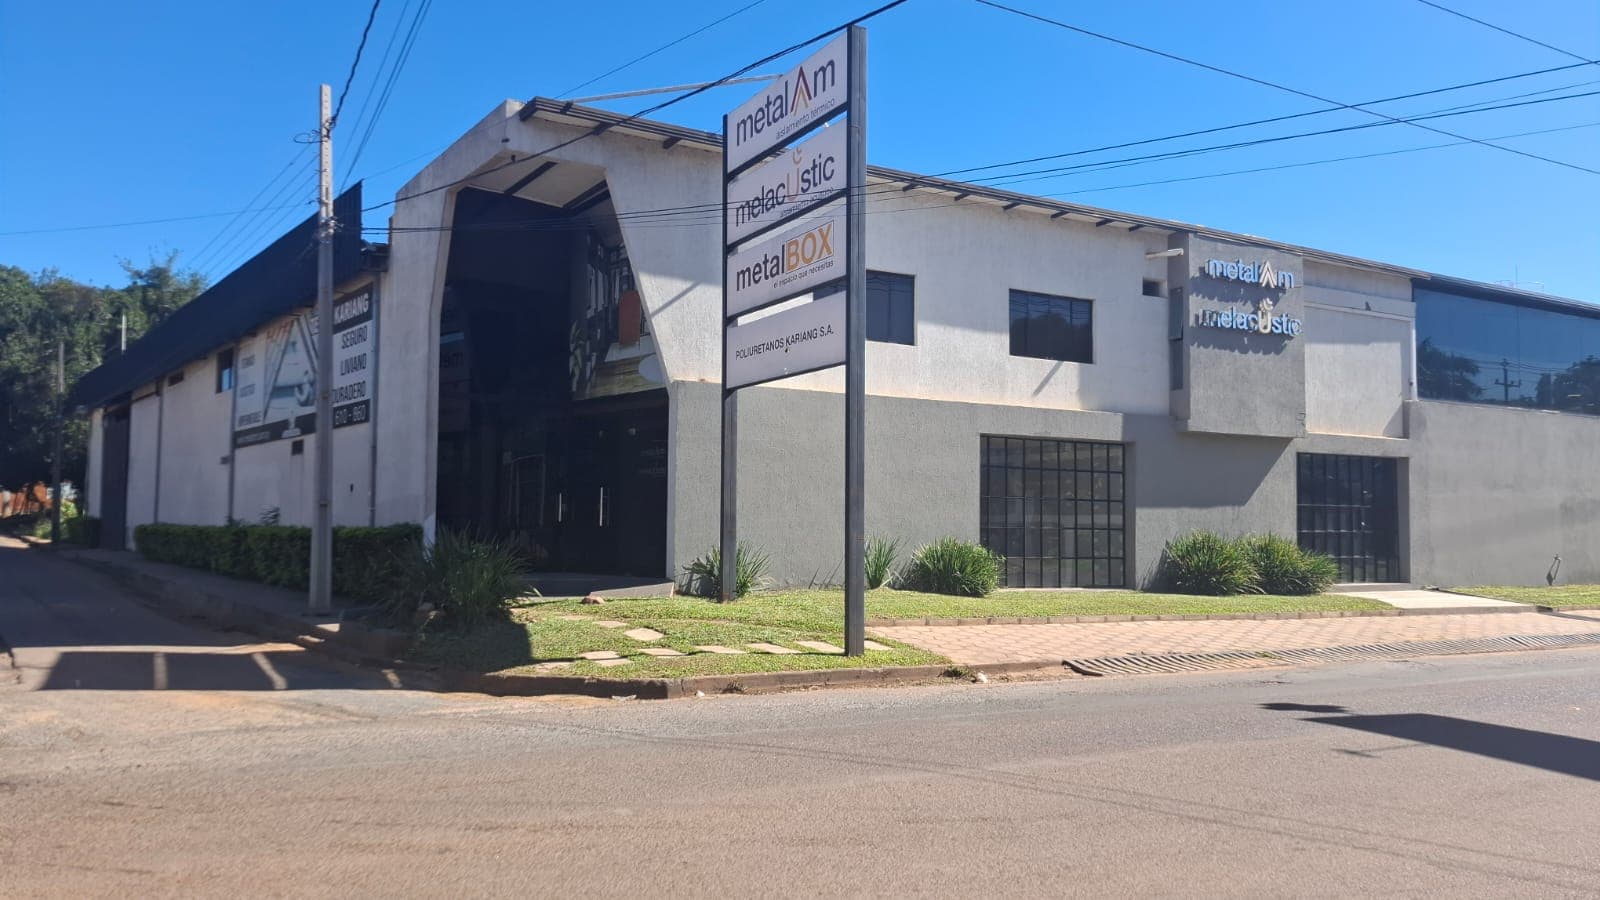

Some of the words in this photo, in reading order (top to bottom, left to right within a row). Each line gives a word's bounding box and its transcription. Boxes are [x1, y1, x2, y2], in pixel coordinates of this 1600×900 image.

[341, 325, 368, 350] SEGURO
[735, 337, 785, 361] POLIURETANOS
[785, 328, 818, 346] KARIANG
[819, 324, 834, 339] S.A.
[340, 352, 367, 376] LIVIANO
